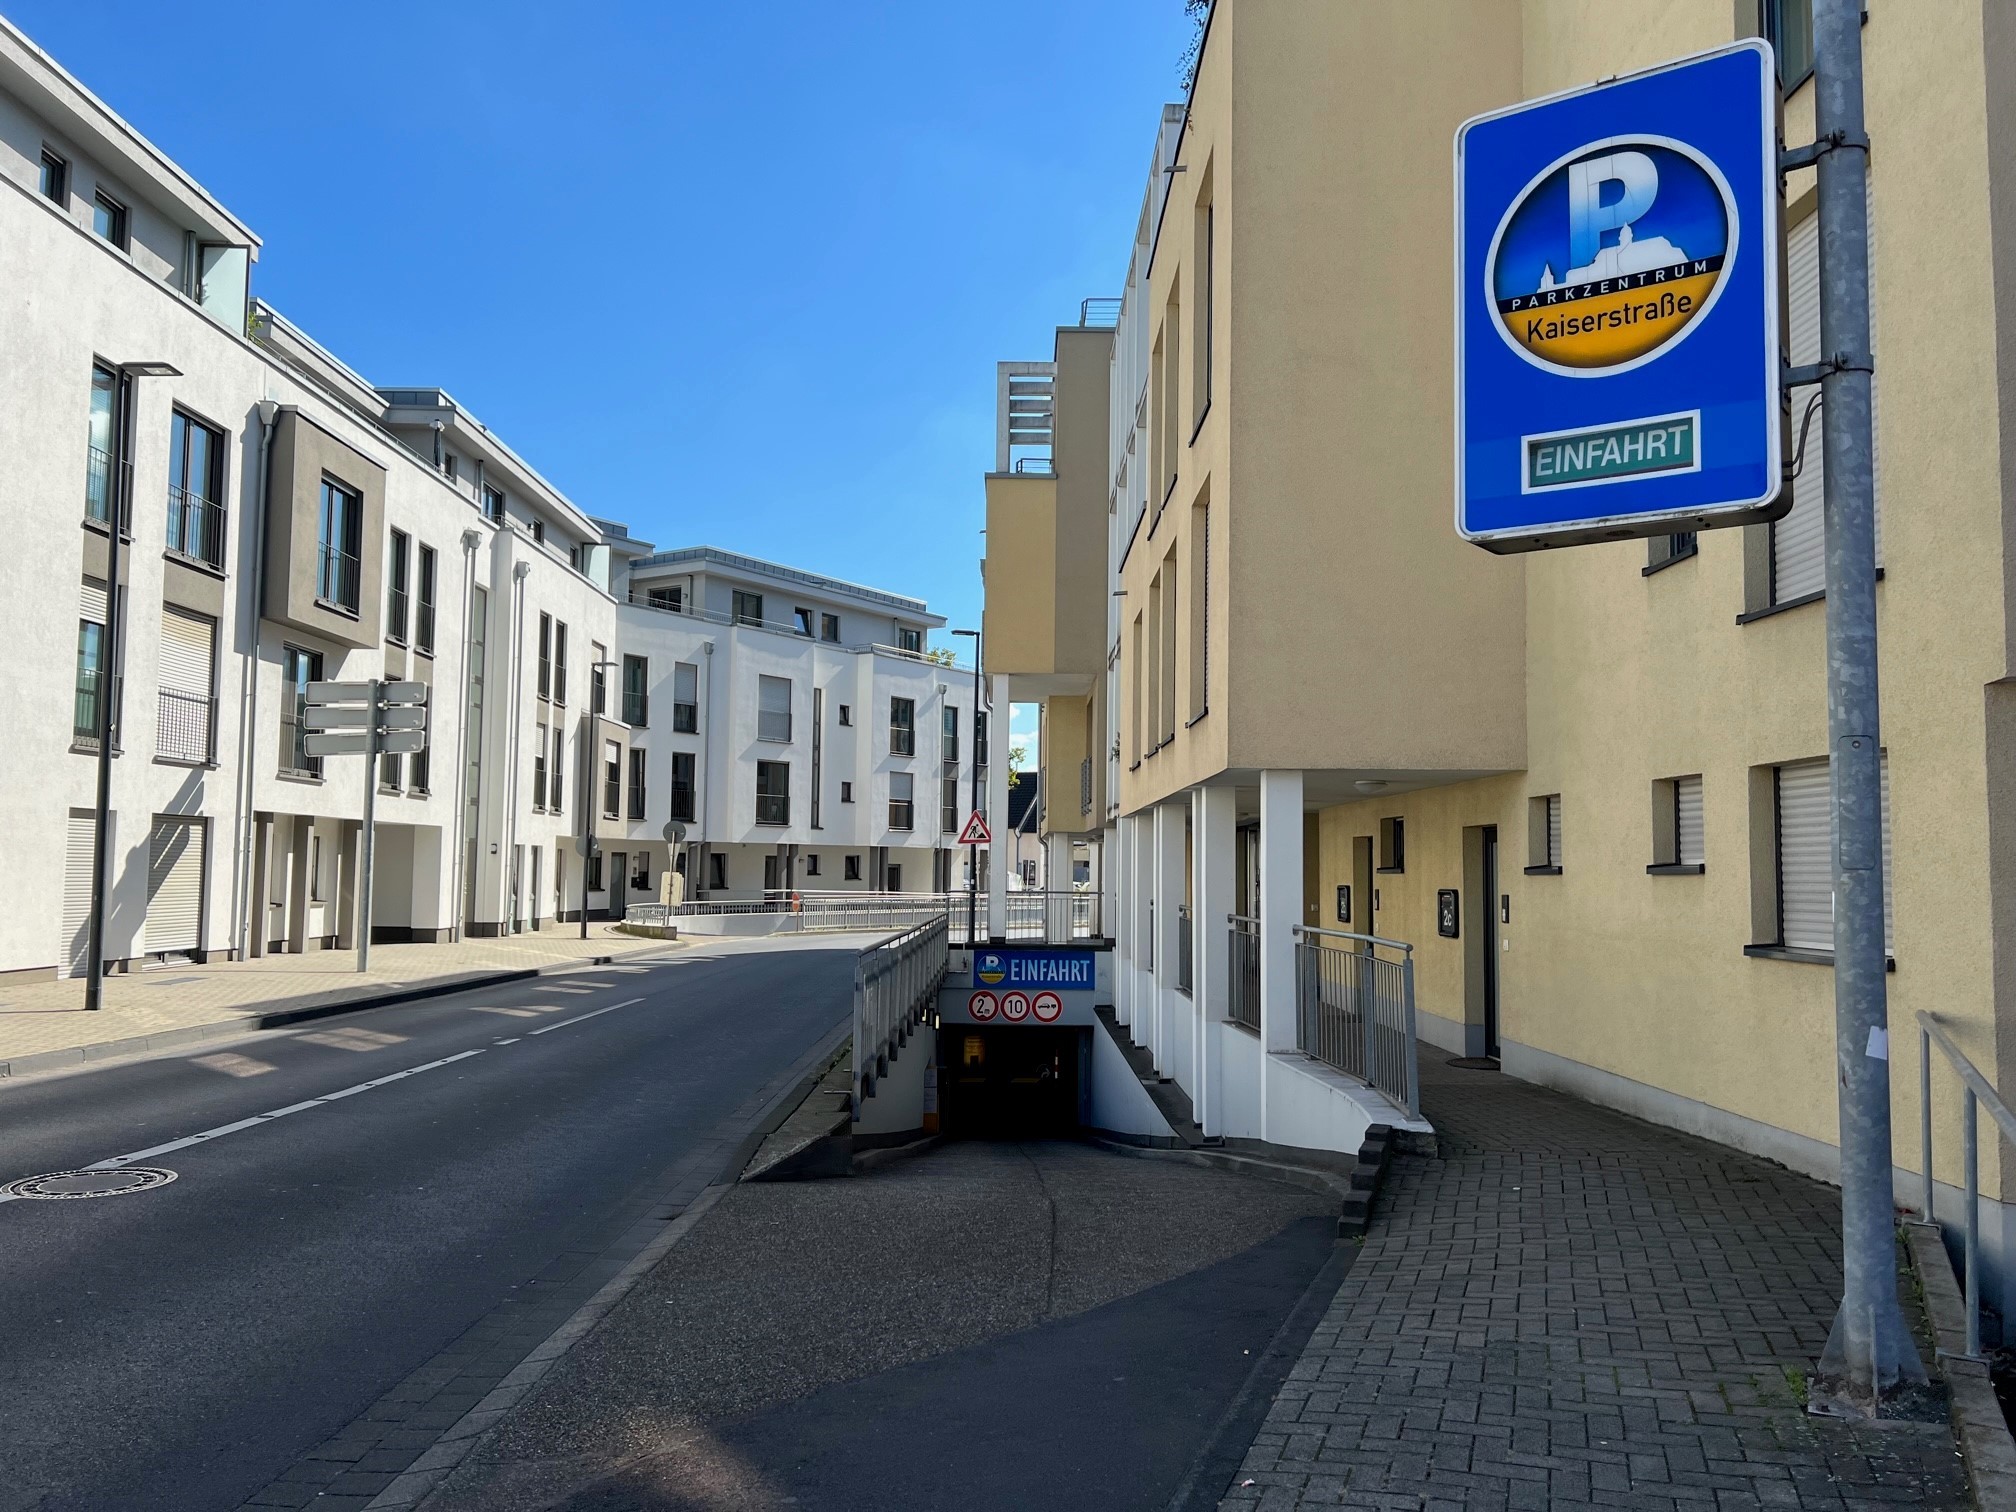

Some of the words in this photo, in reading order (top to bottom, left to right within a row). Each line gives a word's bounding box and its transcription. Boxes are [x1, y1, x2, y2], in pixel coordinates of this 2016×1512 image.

[1569, 151, 1658, 269] P
[1512, 260, 1707, 311] PARKZENTRUM
[1527, 292, 1692, 343] Kaiserstraße
[1536, 425, 1688, 476] EINFAHRT
[1010, 959, 1090, 981] EINFAHRT
[976, 998, 985, 1014] 2
[1008, 999, 1023, 1014] 10
